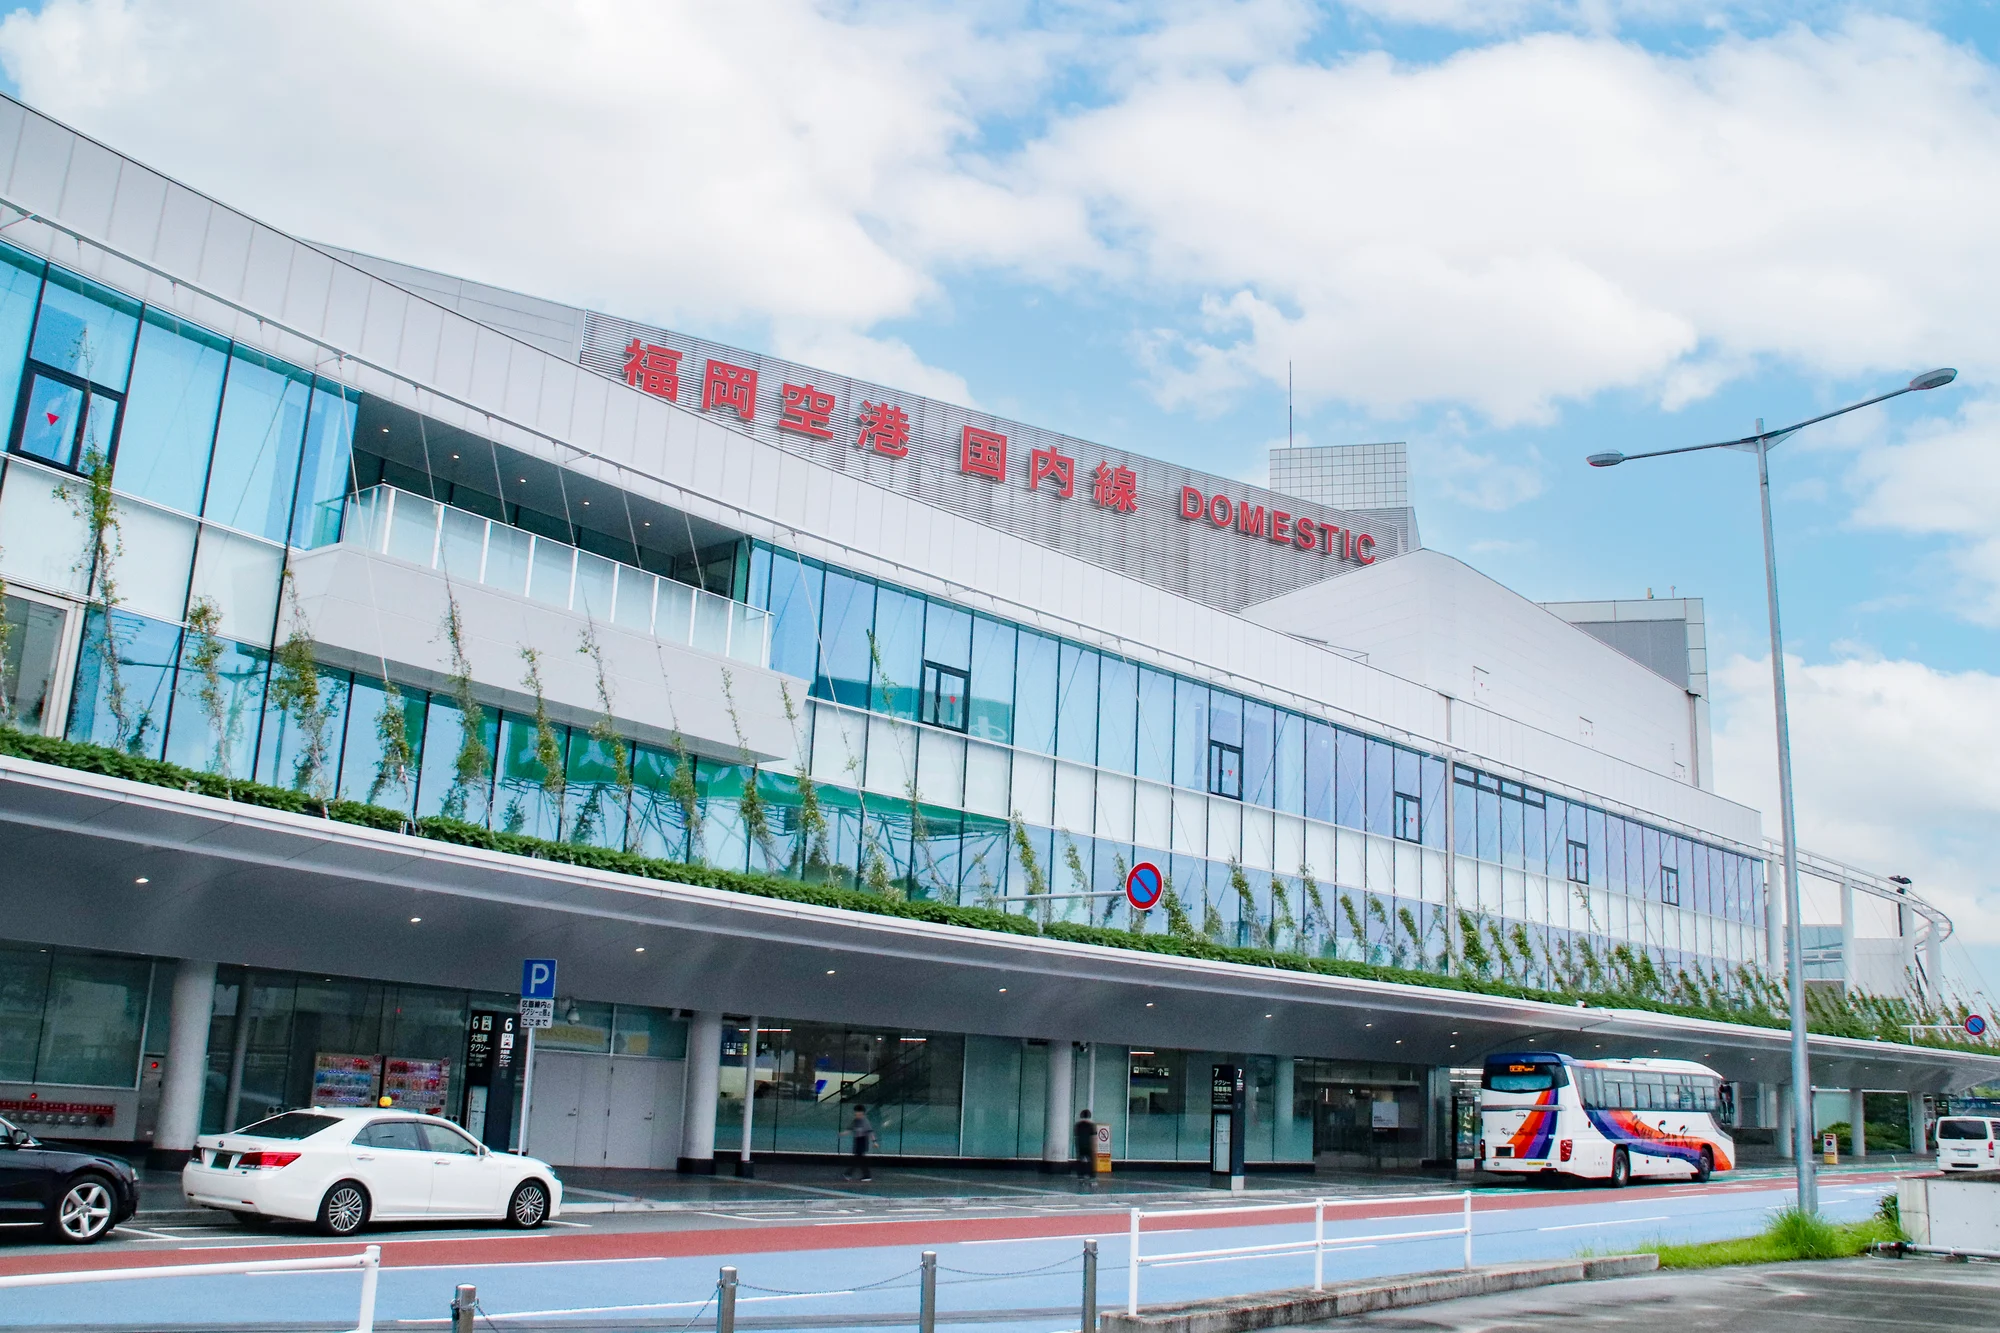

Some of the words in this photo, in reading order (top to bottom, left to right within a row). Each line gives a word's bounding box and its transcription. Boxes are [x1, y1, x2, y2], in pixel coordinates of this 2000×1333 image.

[623, 338, 911, 459] 福岡空港
[960, 424, 1138, 512] 国内線
[1181, 485, 1376, 564] DOMESTIC
[530, 963, 550, 994] P
[472, 1016, 479, 1030] 6
[504, 1017, 513, 1032] 6
[522, 1018, 549, 1027] ここまで
[470, 1043, 491, 1052] タクシー
[1213, 1068, 1219, 1078] 7
[1237, 1068, 1243, 1078] 7
